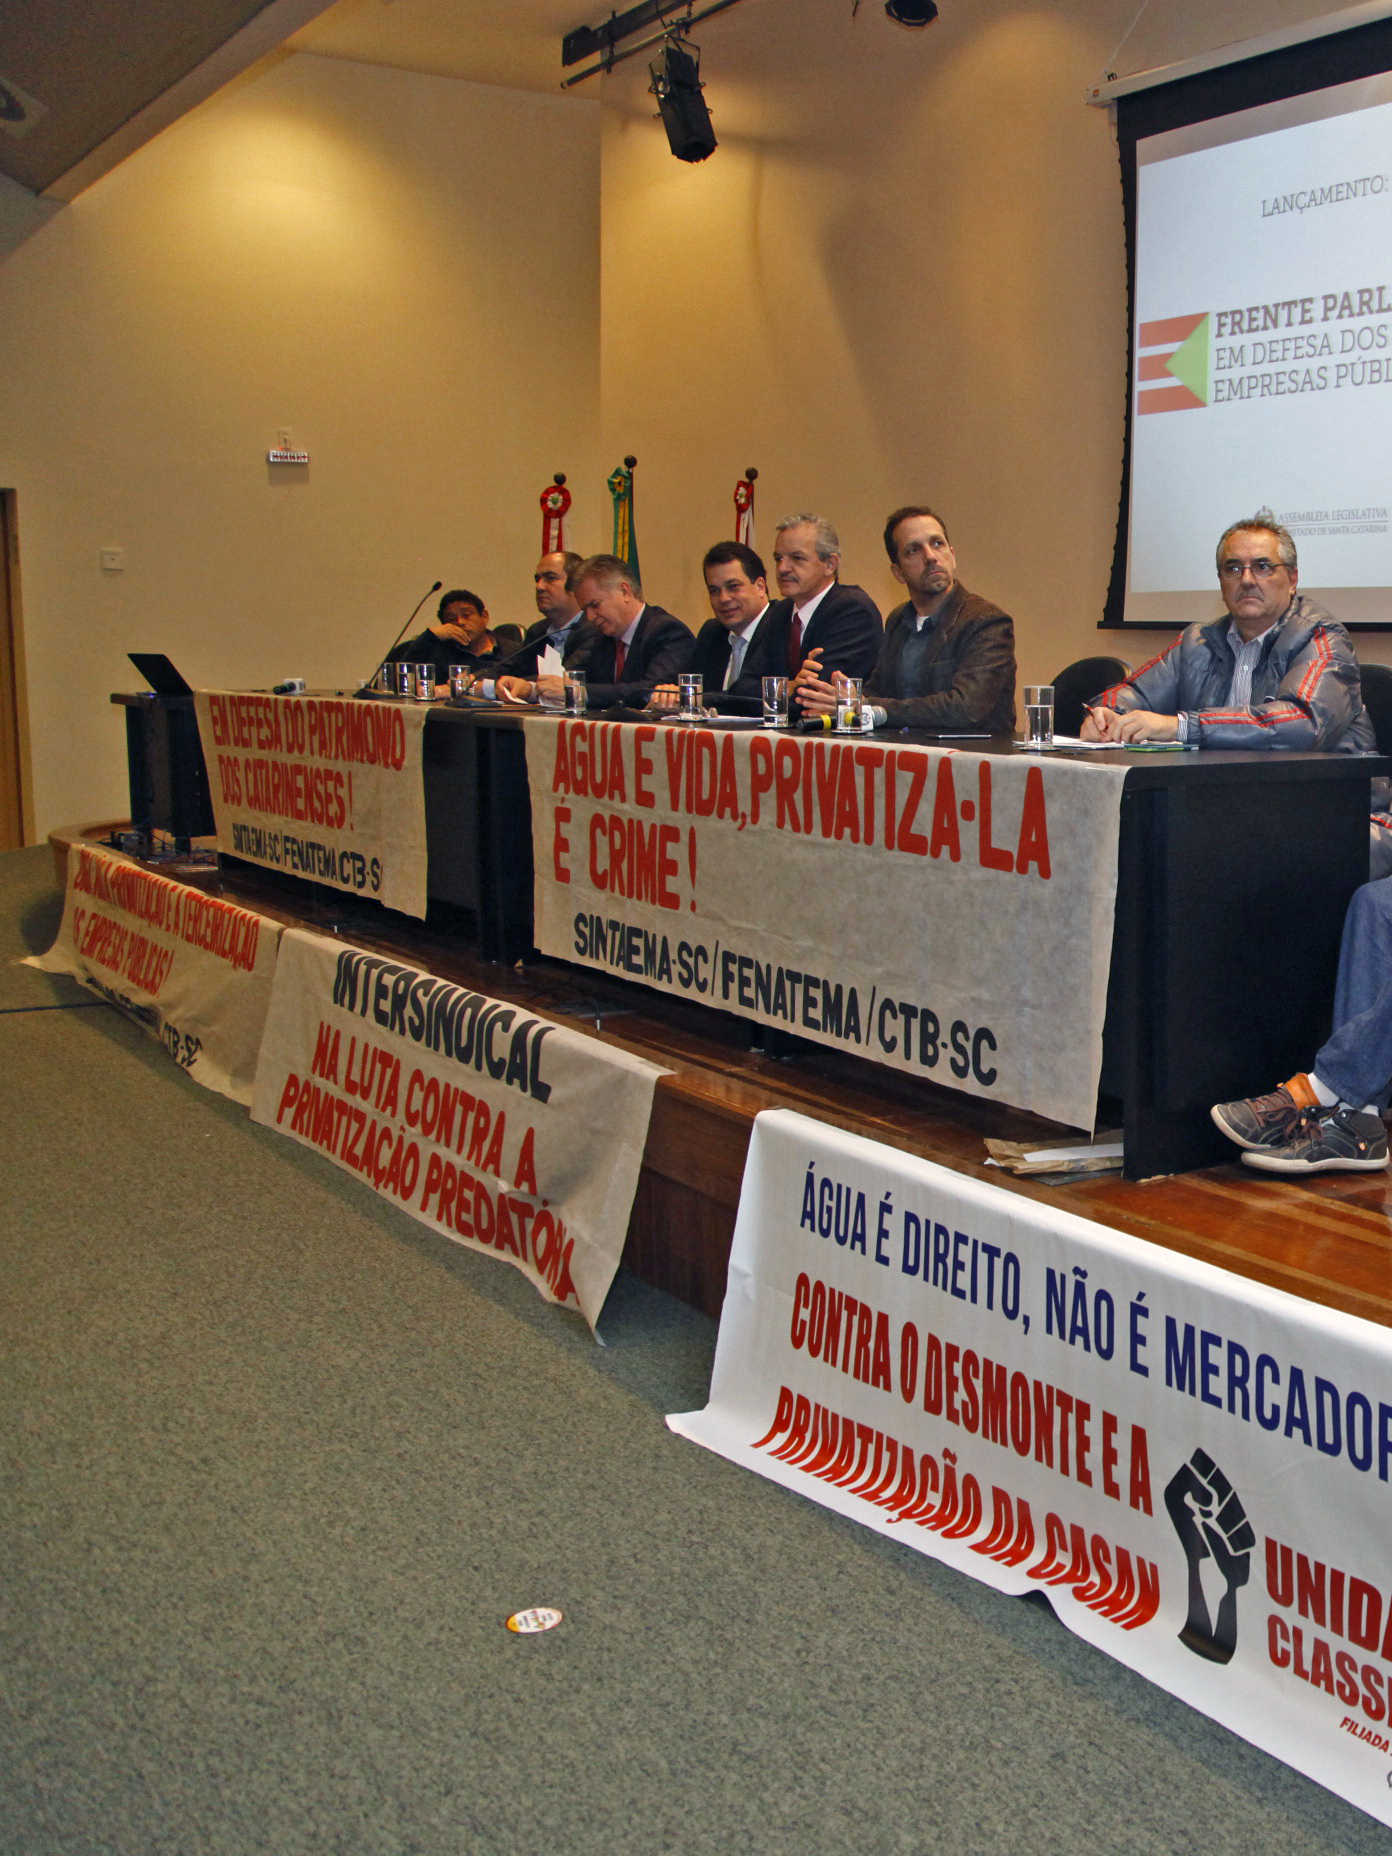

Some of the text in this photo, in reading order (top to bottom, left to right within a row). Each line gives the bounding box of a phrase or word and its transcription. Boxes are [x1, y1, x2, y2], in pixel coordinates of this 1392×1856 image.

[1261, 174, 1389, 218] LANÇAMENTO:
[1215, 297, 1314, 338] FRENTE
[1214, 346, 1245, 371] EM
[1251, 334, 1333, 366] DEFESA
[1339, 324, 1388, 354] DOS
[1213, 366, 1328, 403] EMPRESAS
[1278, 508, 1388, 523] ASSEMBLEIA LEGISLATIVA
[1327, 526, 1350, 535] SANTA
[1351, 525, 1388, 534] CATARINA
[209, 696, 231, 746] EM
[229, 696, 283, 752] DEFESA
[283, 698, 305, 755] DO
[217, 754, 242, 807] DOS
[553, 796, 571, 884] É
[333, 950, 556, 1104] INTERSINDICAL
[311, 1020, 537, 1195] NA LUTA CONTRA A
[276, 1073, 420, 1201] PRIVATIZAÇÃO
[800, 1161, 867, 1257] ÁGUA
[875, 1191, 893, 1267] É
[902, 1210, 1031, 1336] DIREITO,
[1045, 1266, 1115, 1362] NÃO
[1129, 1291, 1150, 1378] É
[790, 1271, 1153, 1518] CONTRA O DESMONTE E A
[749, 1384, 1161, 1632] PRIVATIZAÇÃO DA CASAN
[1339, 1716, 1390, 1753] FILIADA
